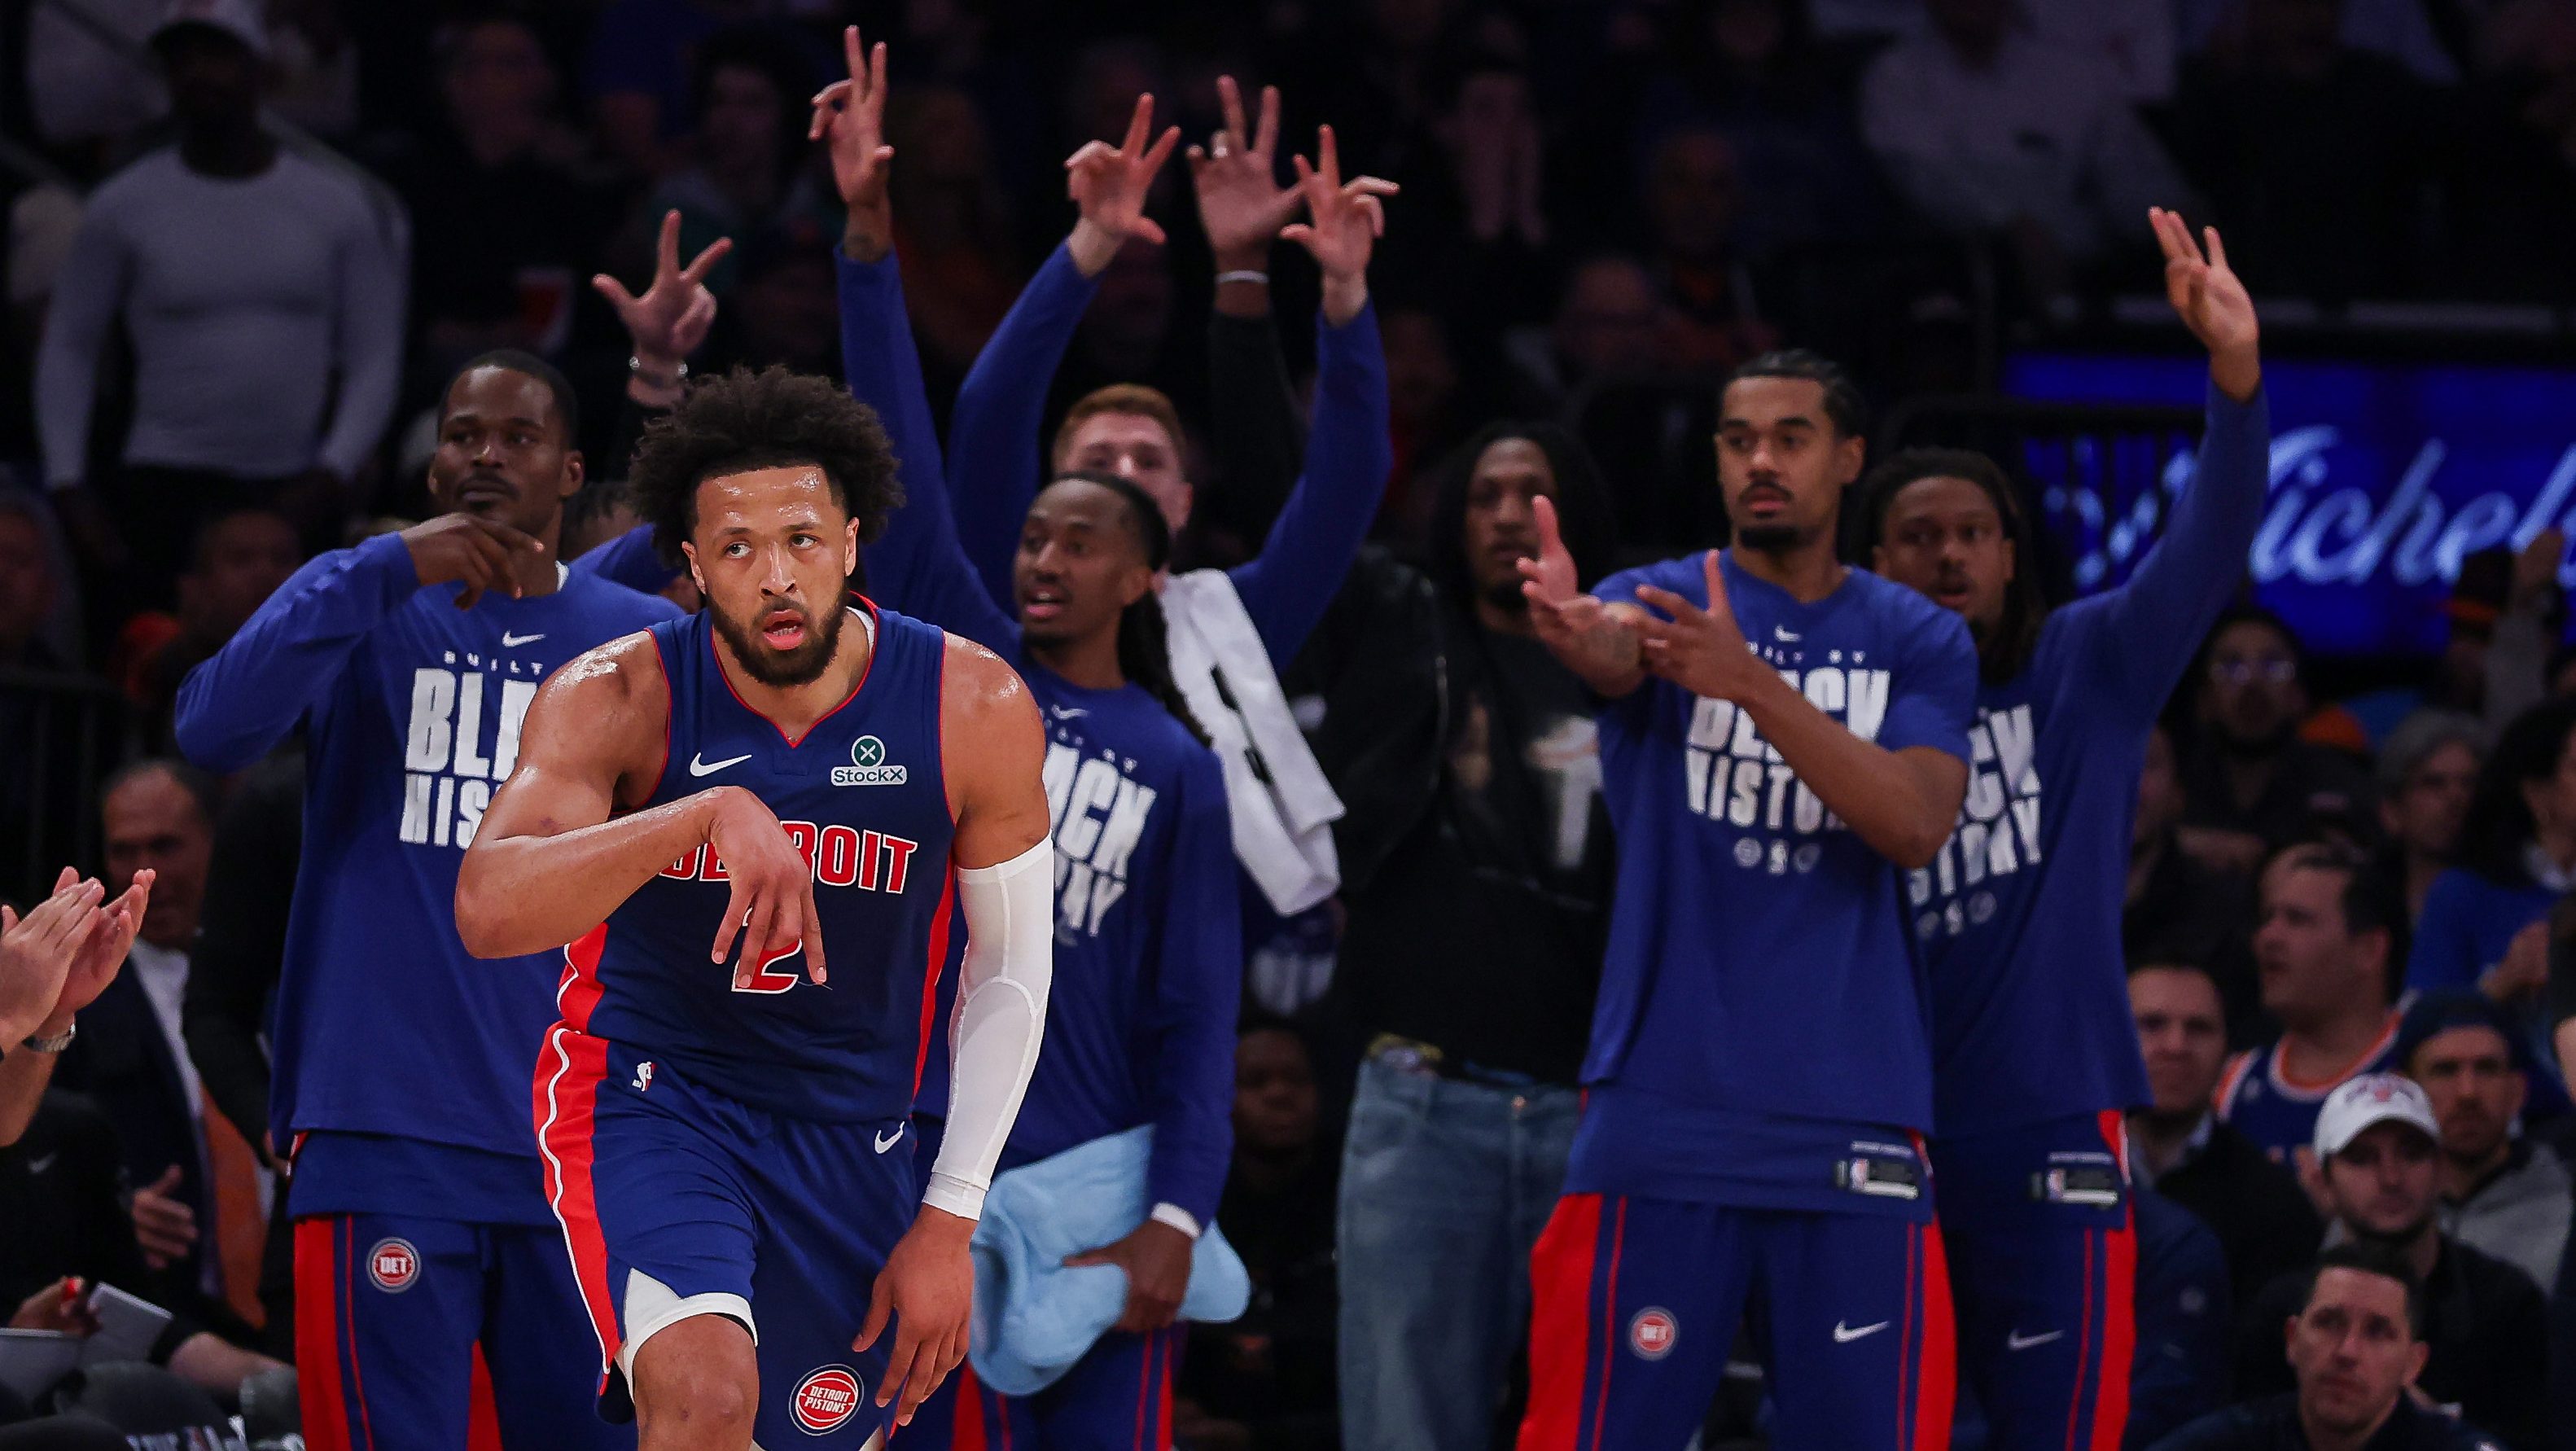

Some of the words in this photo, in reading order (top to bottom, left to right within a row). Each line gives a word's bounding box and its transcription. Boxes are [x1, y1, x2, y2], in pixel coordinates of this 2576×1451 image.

[444, 651, 543, 675] BUILT
[405, 668, 538, 782] BLA
[833, 768, 904, 783] StockX
[1684, 747, 1848, 834] HISTO
[1041, 742, 1158, 880] ACK
[659, 821, 918, 894] ROIT
[804, 1396, 848, 1414] PISTONS
[809, 1385, 851, 1402] DETROIT
